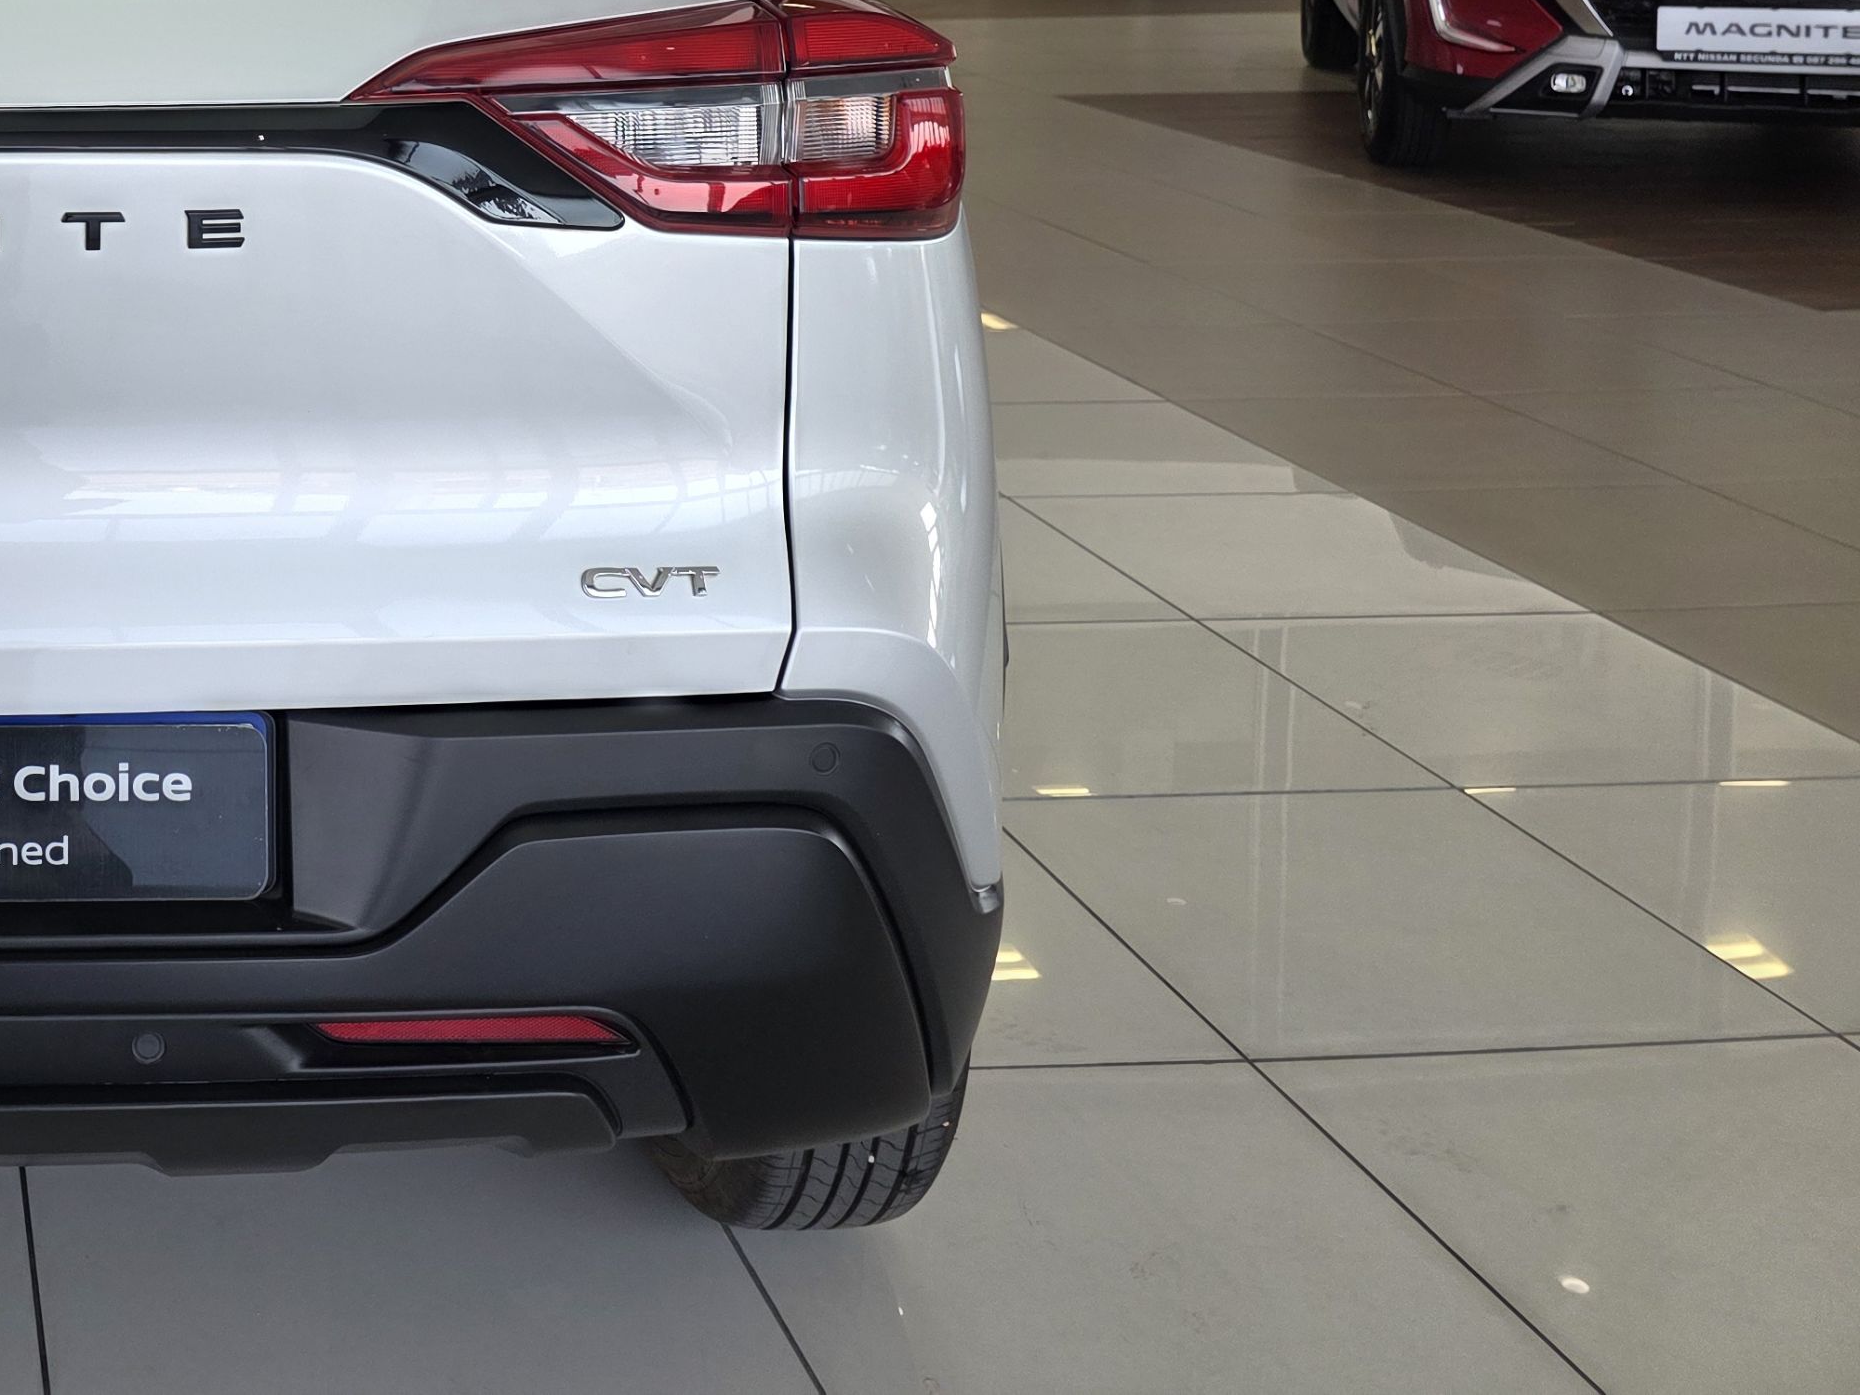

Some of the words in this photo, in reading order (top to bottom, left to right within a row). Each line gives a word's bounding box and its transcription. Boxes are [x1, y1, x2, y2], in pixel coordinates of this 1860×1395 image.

[1685, 21, 1860, 39] MAGNITE
[1674, 52, 1696, 61] NTT
[1697, 53, 1738, 62] NISSAN
[1739, 53, 1789, 65] SECUNDA
[580, 566, 721, 598] CVT
[13, 762, 193, 803] Choice
